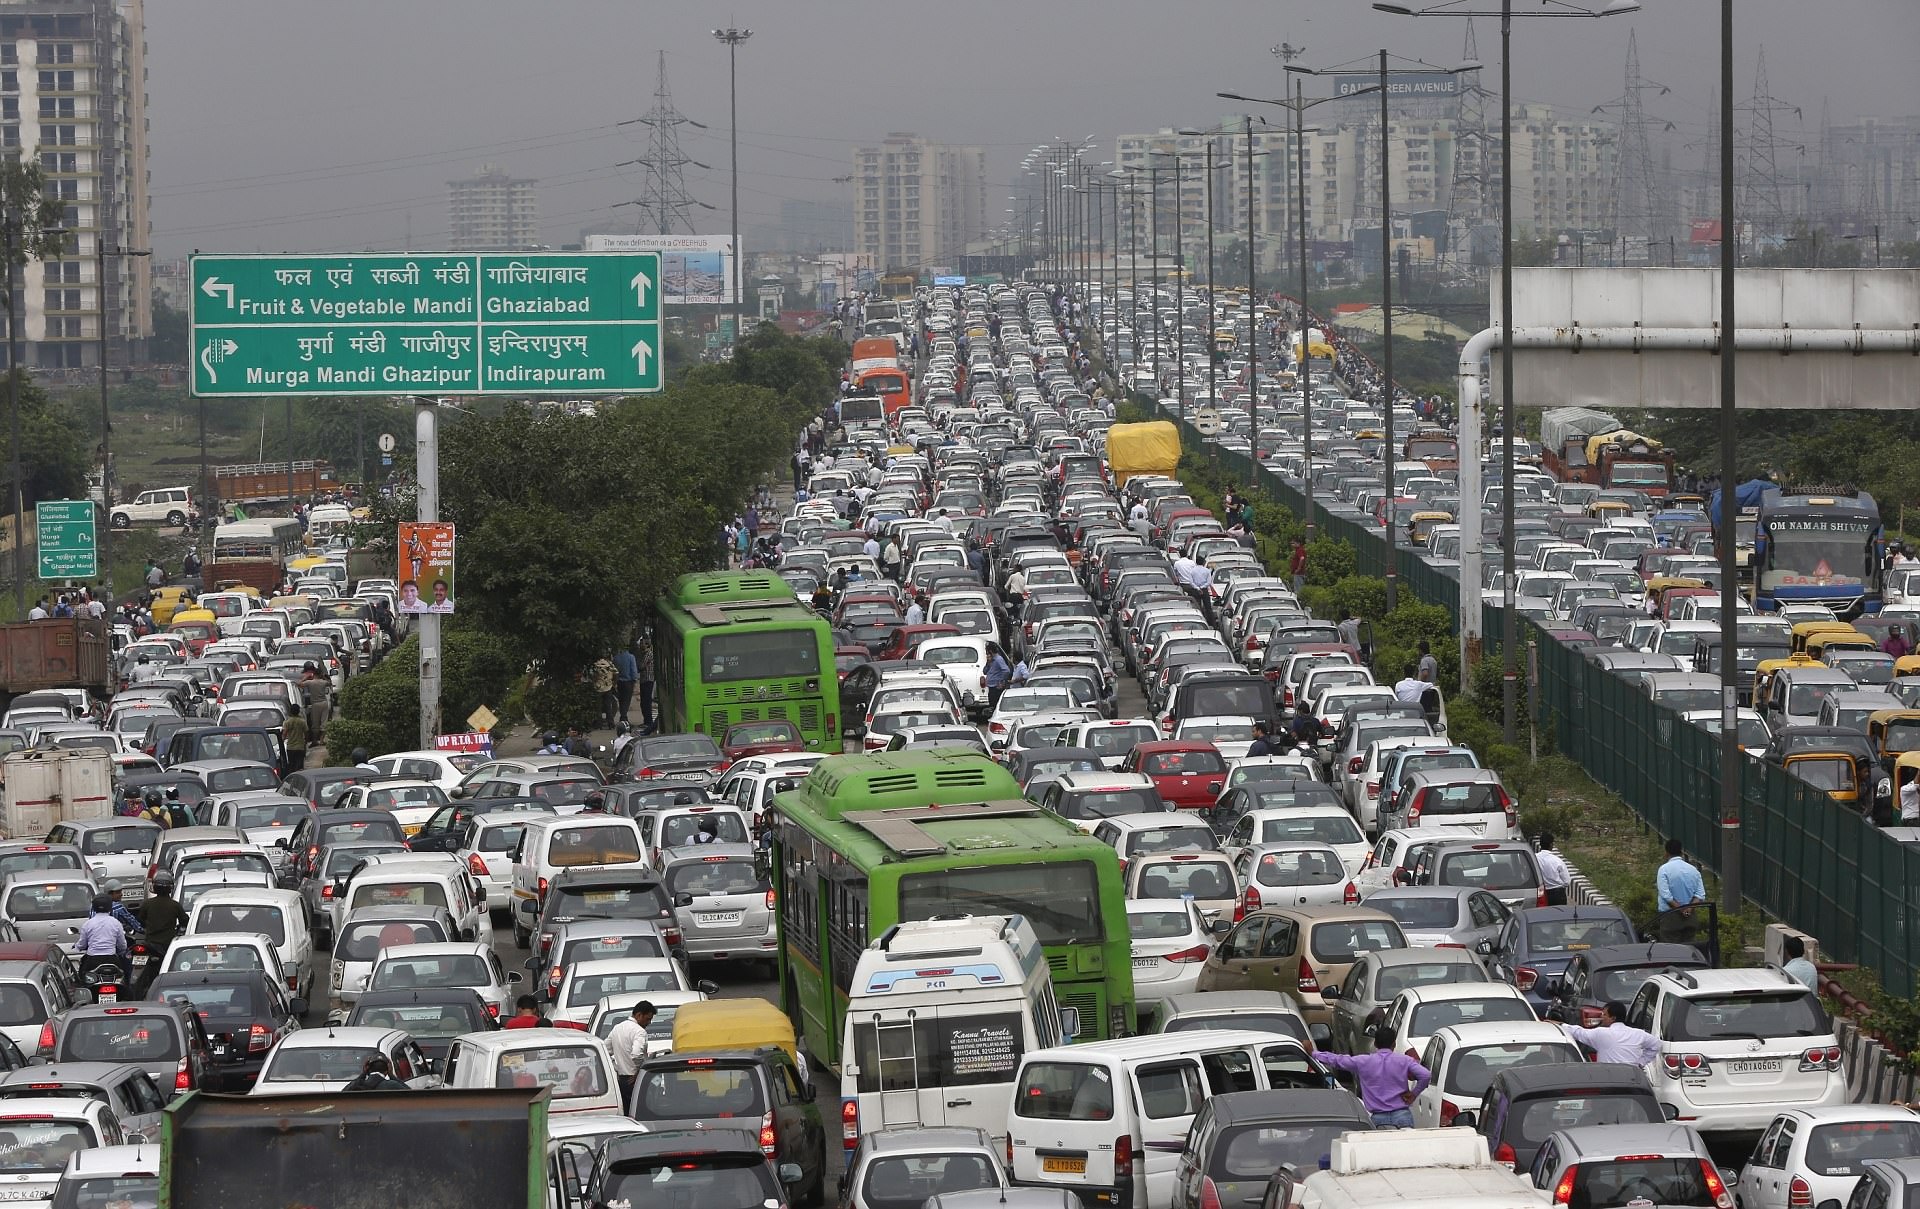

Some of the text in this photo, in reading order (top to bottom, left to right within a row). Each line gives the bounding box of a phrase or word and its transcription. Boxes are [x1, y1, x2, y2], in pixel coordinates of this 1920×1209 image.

[1413, 81, 1454, 92] AVENUE
[672, 239, 707, 247] CYBERHUB
[274, 261, 471, 288] फल एवं सब्जी मंडी
[486, 261, 588, 284] गाजियाबाद
[239, 297, 472, 318] Fruit & Vegetable Mandi
[486, 297, 590, 314] Ghaziabad
[297, 330, 472, 361] मुर्गा मंडी गाजीपुर
[487, 330, 588, 358] इन्दिरापुरम्
[247, 365, 472, 388] Murga Mandi Ghazipur
[487, 365, 606, 385] Indirapuram
[1770, 521, 1869, 532] OM NAMAH SHIVAY
[437, 736, 449, 747] UP
[474, 733, 490, 744] TAX
[1131, 958, 1158, 967] CG0122
[981, 1028, 1010, 1037] Travels
[1733, 1061, 1781, 1072] CH01AQ6051
